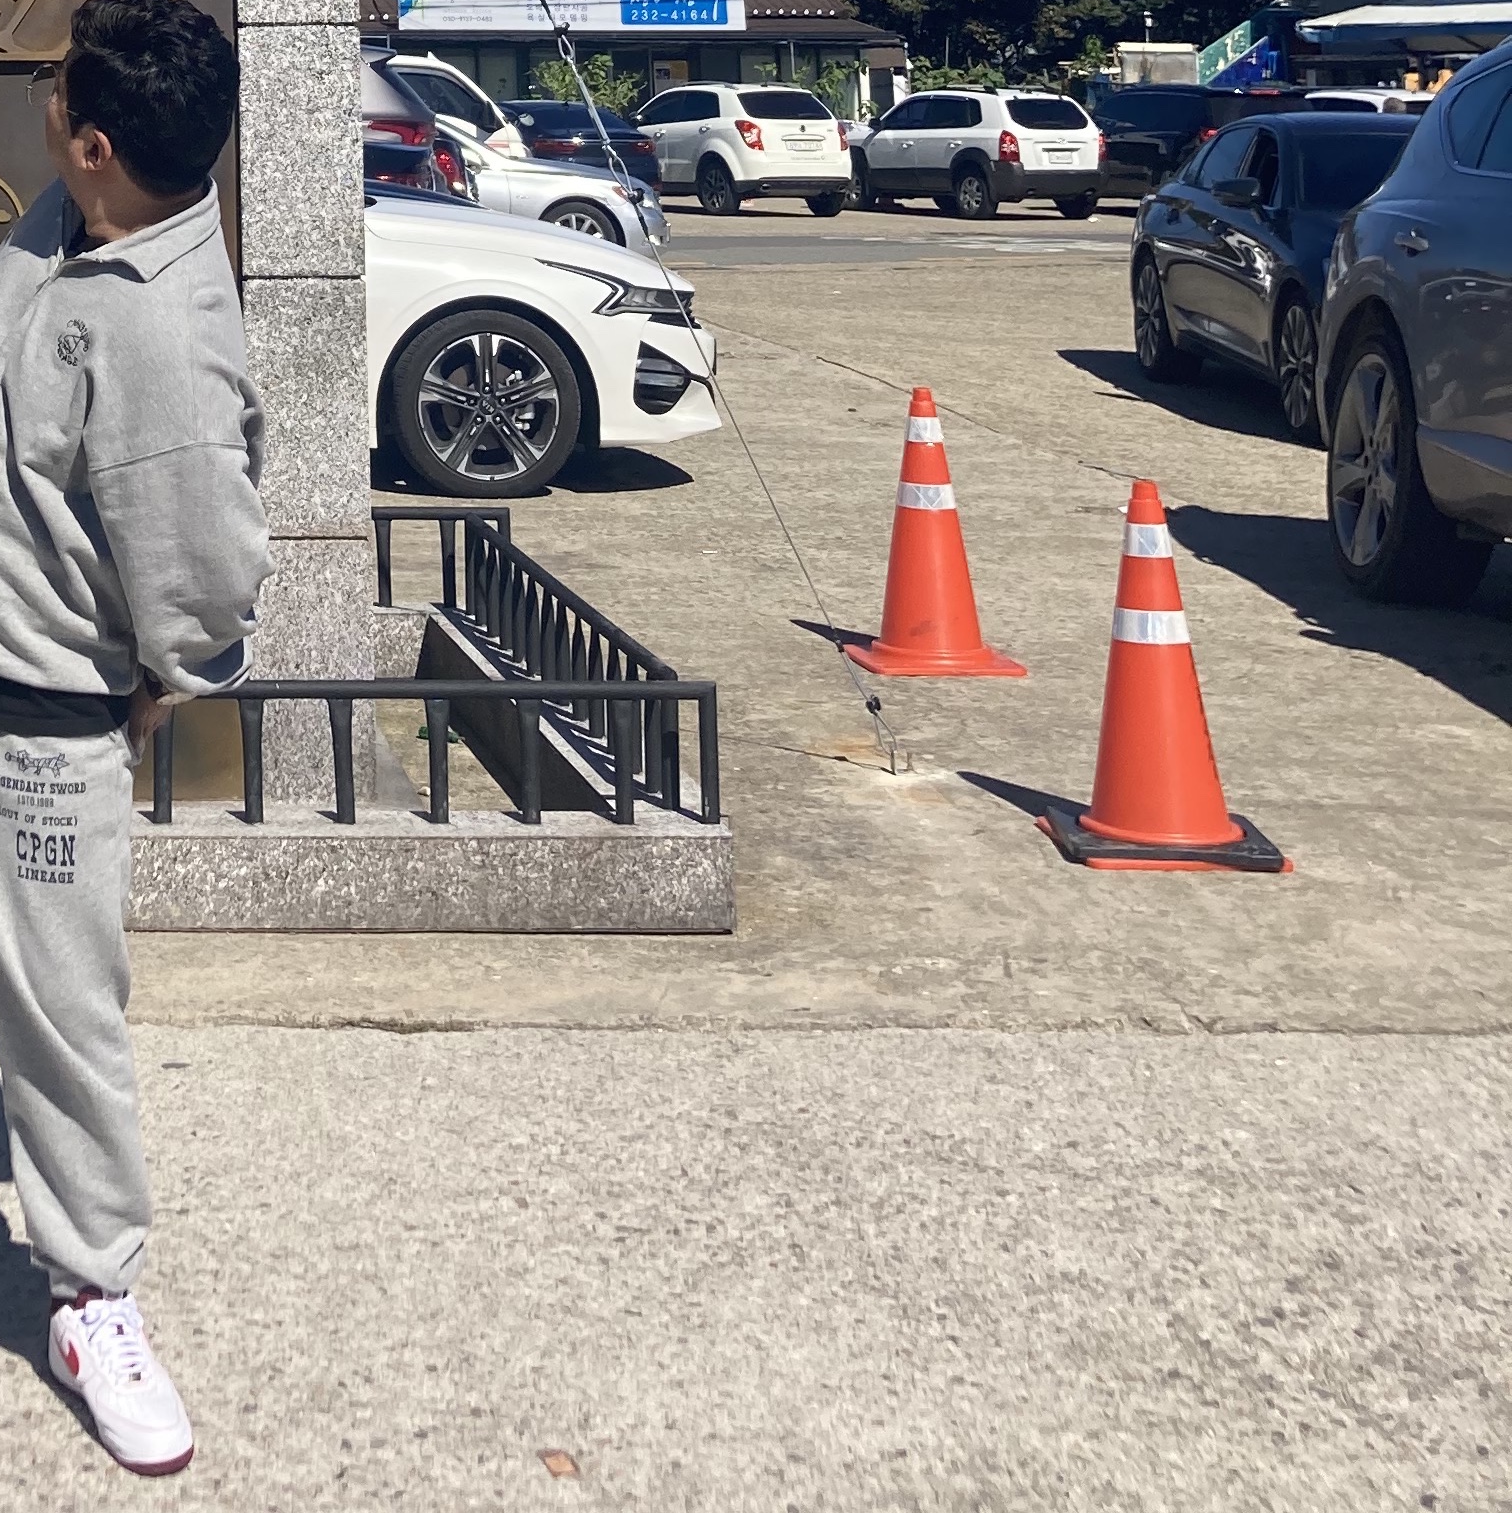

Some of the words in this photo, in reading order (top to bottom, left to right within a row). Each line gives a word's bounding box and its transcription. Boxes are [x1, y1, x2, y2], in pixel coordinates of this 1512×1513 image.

[631, 9, 708, 21] 232-4164
[481, 399, 495, 414] KIA
[49, 780, 87, 794] SWORD
[24, 814, 37, 824] OF
[41, 815, 78, 828] STOCK)
[16, 829, 76, 867] CPGN
[17, 865, 75, 884] LINEAGE
